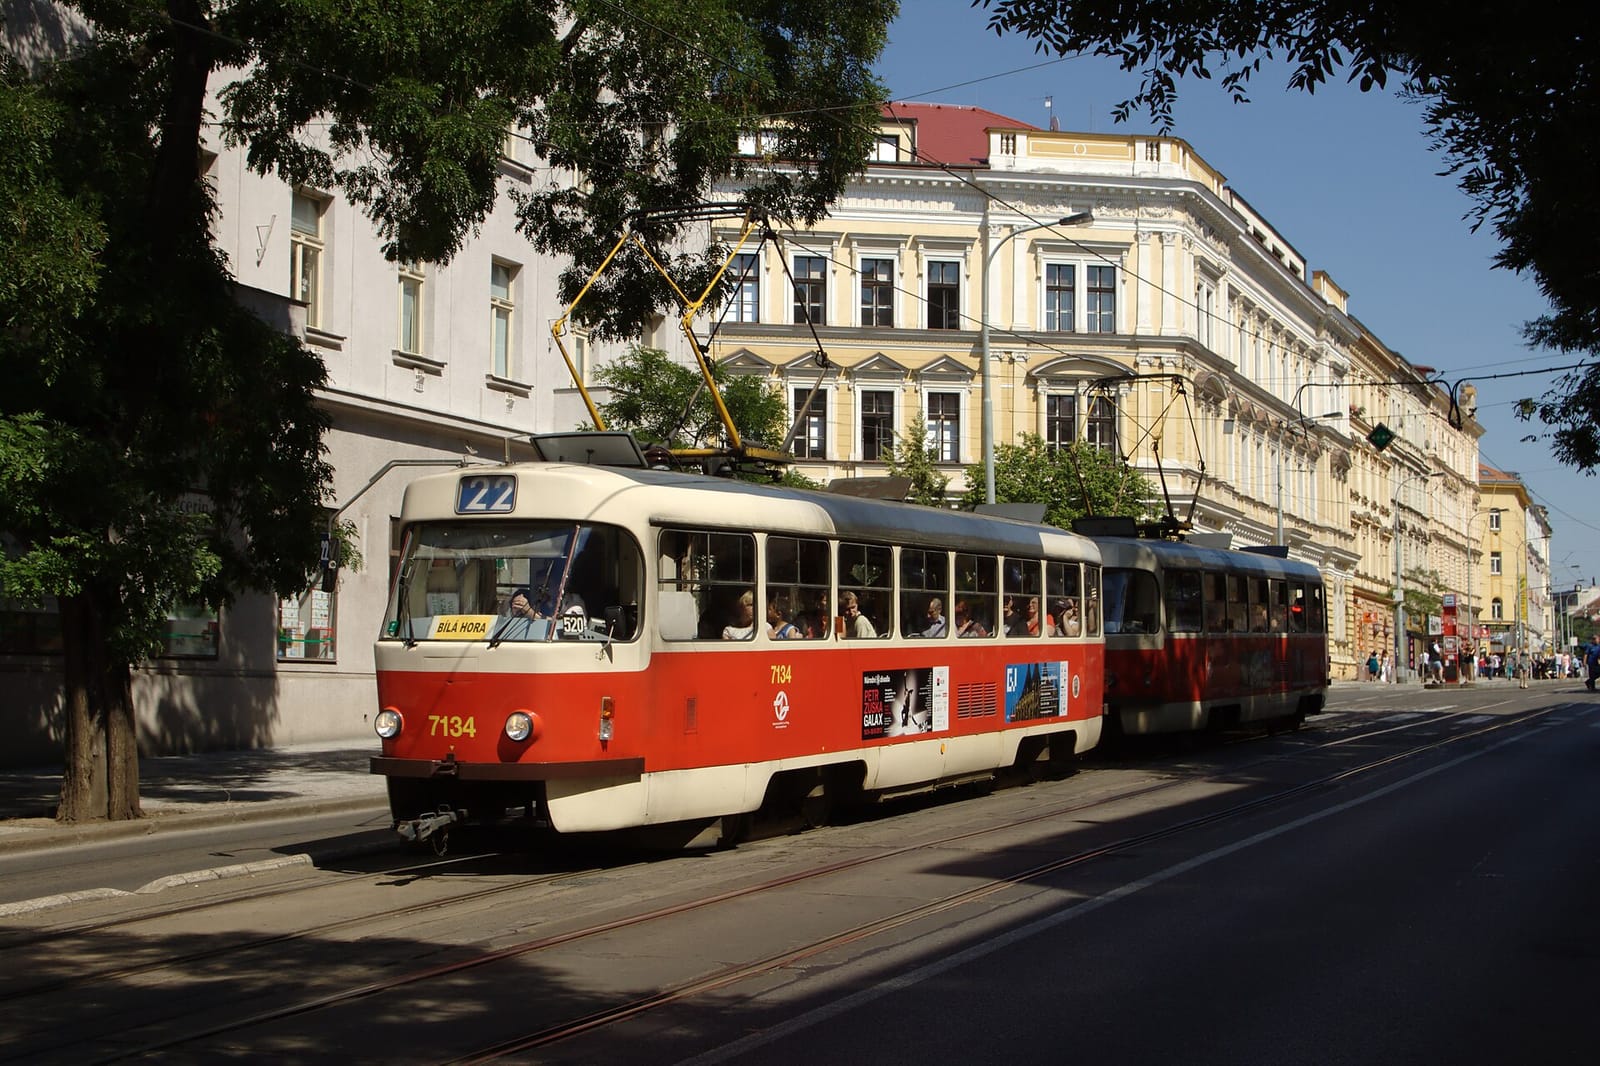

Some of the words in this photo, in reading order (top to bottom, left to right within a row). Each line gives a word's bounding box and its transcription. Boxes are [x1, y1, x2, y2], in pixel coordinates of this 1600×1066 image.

[465, 477, 513, 510] 22
[436, 619, 458, 633] BÍLÁ
[459, 621, 487, 633] HORA
[563, 616, 584, 633] 520
[771, 665, 792, 684] 7134
[864, 689, 879, 702] PETR
[428, 715, 477, 738] 7134
[864, 713, 883, 727] GALAX
